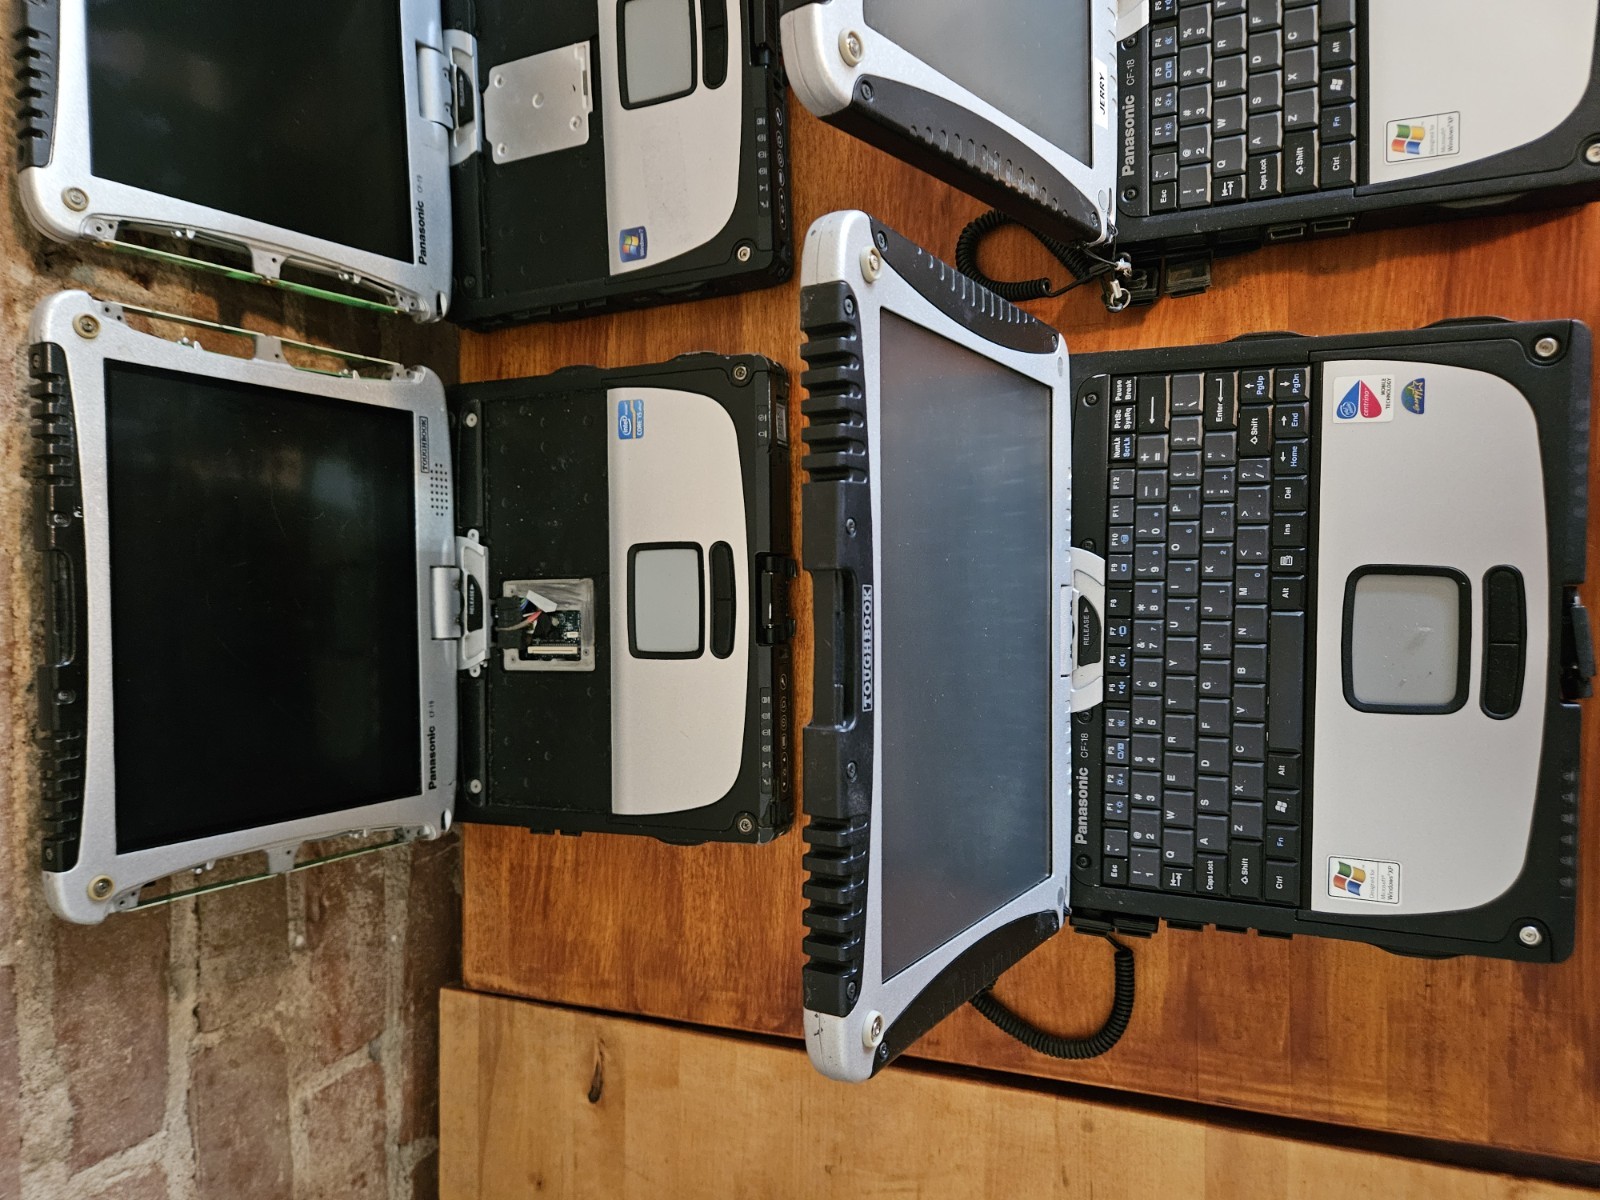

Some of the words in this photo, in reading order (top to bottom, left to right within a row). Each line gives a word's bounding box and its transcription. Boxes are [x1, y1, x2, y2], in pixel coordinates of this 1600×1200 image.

[1155, 1, 1161, 10] F5
[1183, 28, 1192, 38] %
[1288, 32, 1297, 40] C
[1155, 38, 1161, 47] F4
[1217, 40, 1226, 48] R
[1126, 59, 1135, 86] CF-18
[1155, 68, 1161, 77] F3
[1155, 97, 1161, 106] F2
[1217, 119, 1226, 128] W
[1333, 117, 1340, 127] Fn
[1122, 95, 1135, 177] Panasonic
[1155, 127, 1161, 136] F1
[1183, 149, 1191, 157] @
[1217, 160, 1225, 168] Q
[1260, 175, 1268, 190] Caps
[416, 200, 427, 265] Panasonic
[1292, 374, 1300, 393] PgDn
[1124, 408, 1132, 429] SysRq
[1110, 627, 1116, 635] F7
[862, 589, 872, 707] TOUGHBOOK
[1080, 732, 1089, 759] CF-18
[427, 725, 437, 790] Panasonic
[1107, 775, 1114, 783] F2
[1075, 767, 1089, 845] Panasonic
[1107, 803, 1113, 811] F1
[1167, 811, 1175, 819] W
[1277, 838, 1283, 846] Fn
[1206, 876, 1214, 890] Caps
